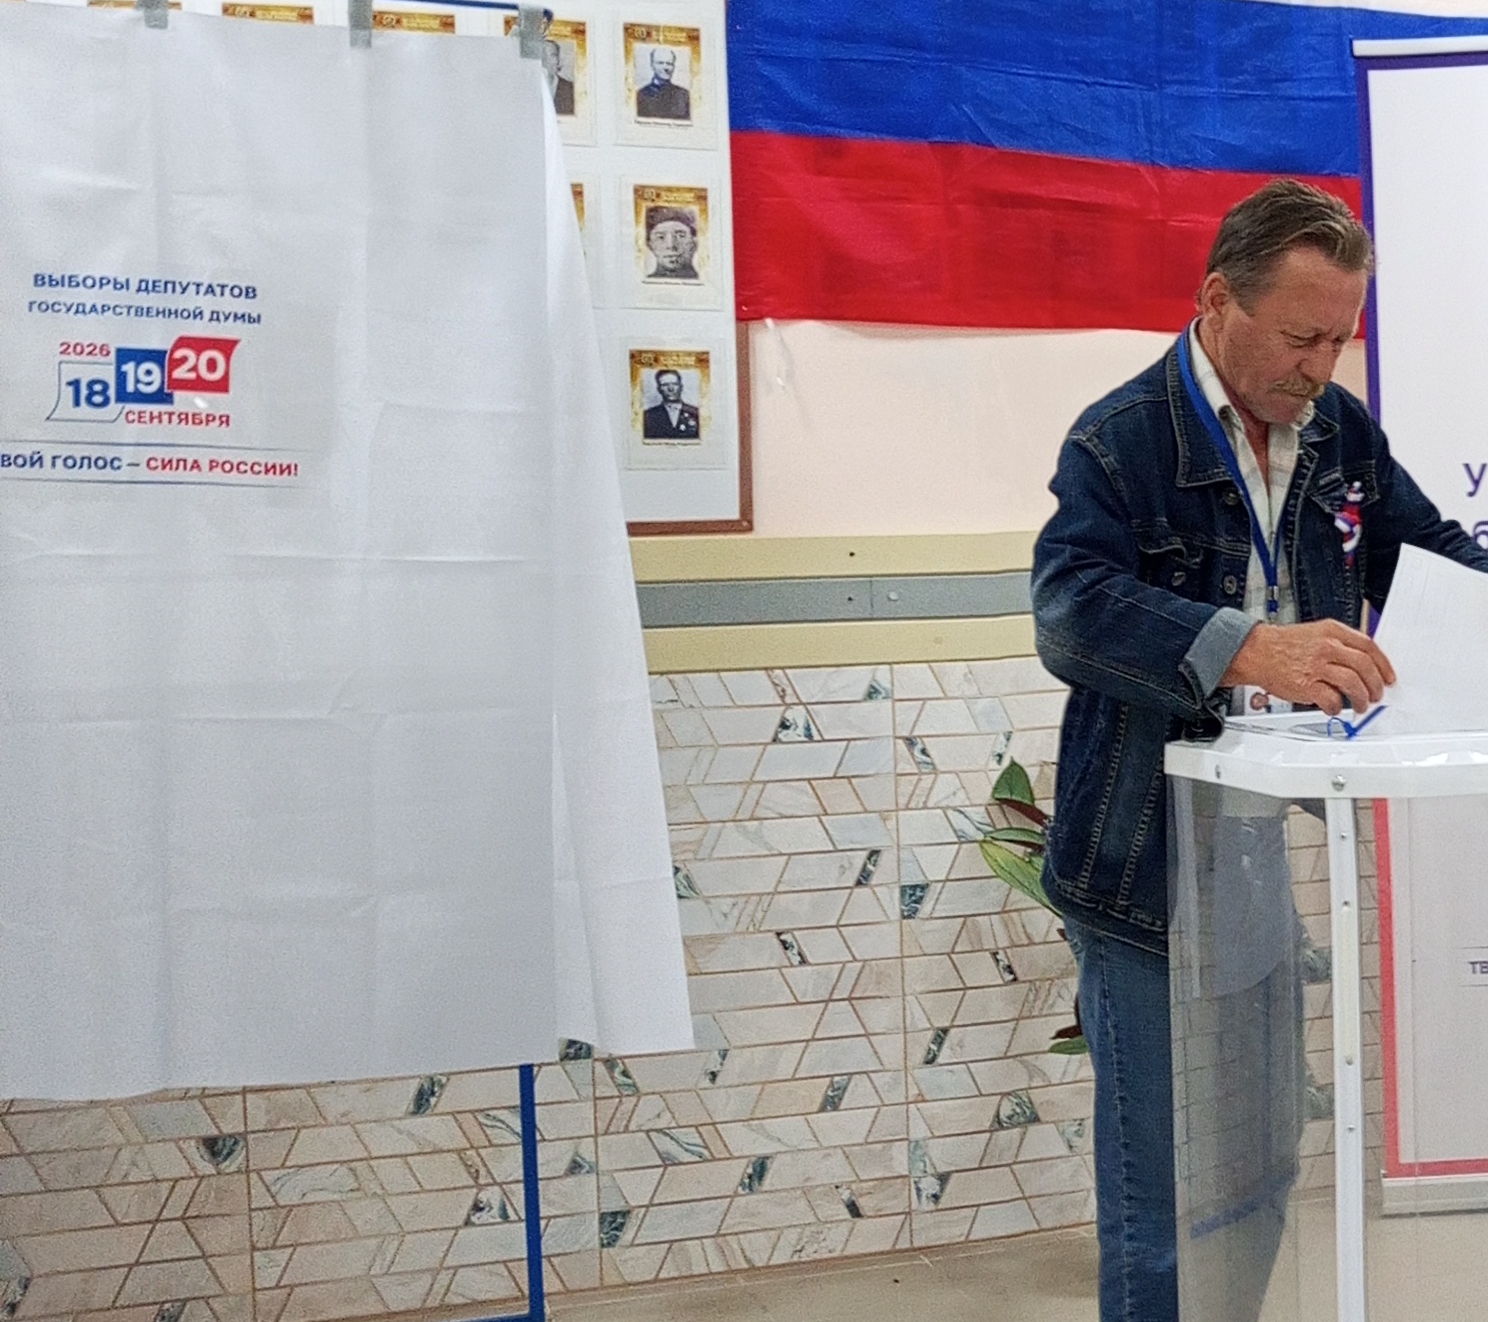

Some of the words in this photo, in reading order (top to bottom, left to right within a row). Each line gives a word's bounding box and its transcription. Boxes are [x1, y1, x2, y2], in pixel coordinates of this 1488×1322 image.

[33, 273, 130, 292] ВЫБОРЫ
[136, 278, 258, 300] ДЕПУТАТОВ
[28, 300, 204, 322] ГОСУДАРСТВЕННОЙ
[208, 309, 262, 325] ДУМЫ
[59, 342, 111, 357] 2026
[65, 378, 111, 409] 18
[120, 361, 162, 394] 19
[171, 348, 226, 382] 20
[124, 410, 231, 428] СЕНТЯБРЯ
[51, 454, 123, 471] ГОЛОС
[146, 456, 201, 473] СИЛА
[208, 459, 299, 477] РОССИИ!
